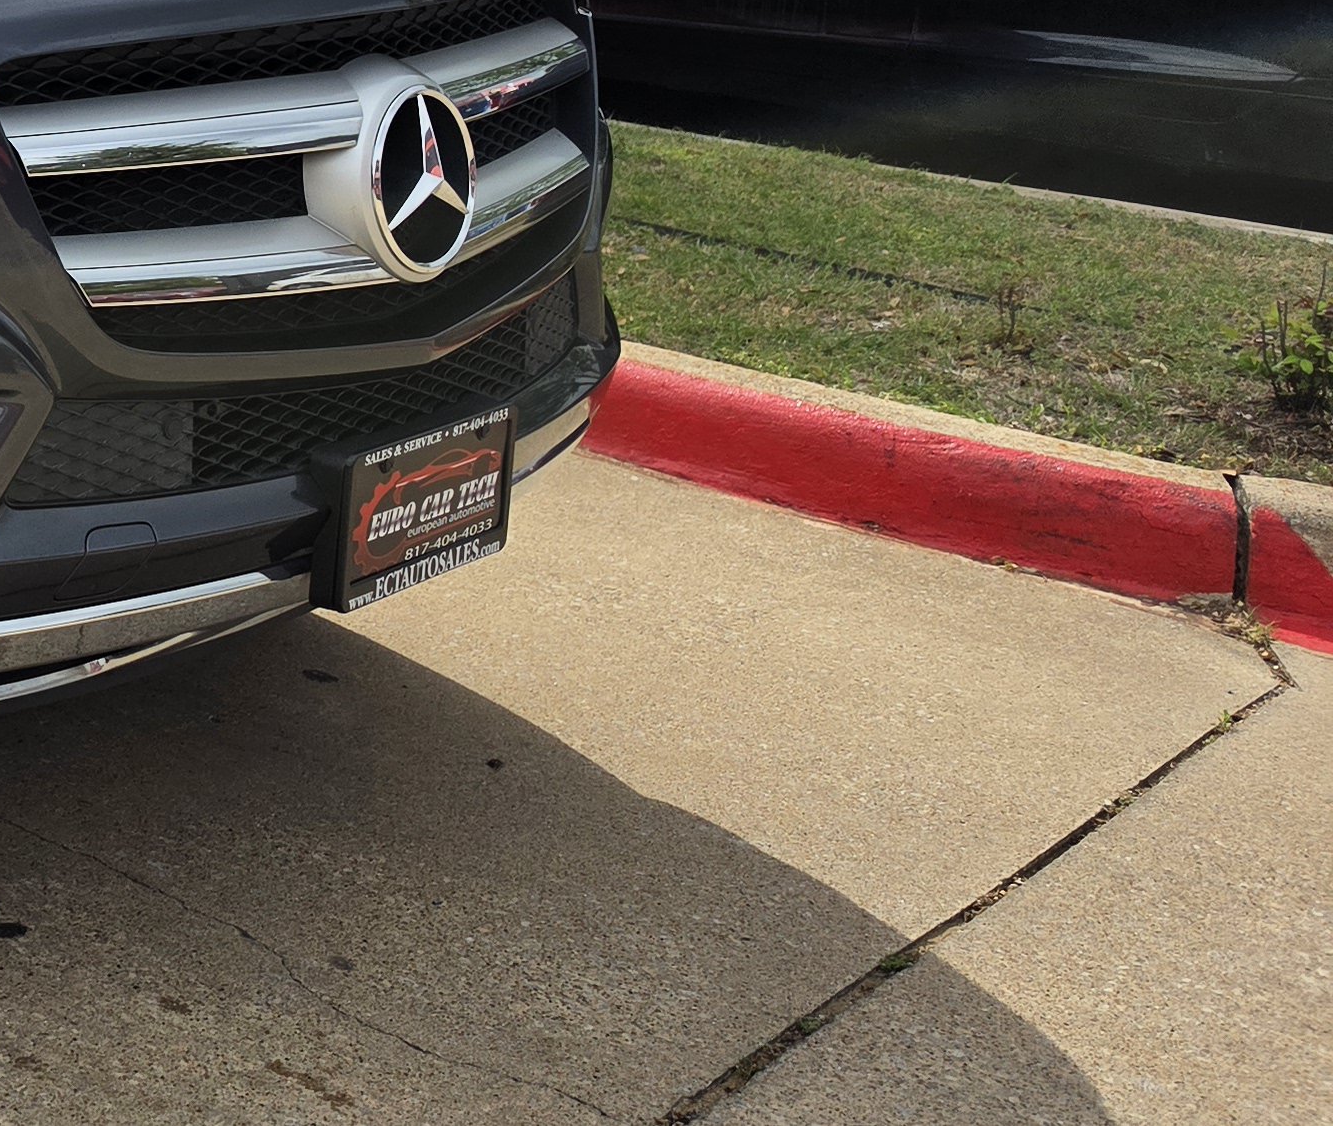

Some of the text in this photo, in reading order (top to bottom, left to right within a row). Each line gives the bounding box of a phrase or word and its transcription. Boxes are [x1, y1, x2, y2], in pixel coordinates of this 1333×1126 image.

[364, 407, 509, 467] SALES & SERVICE 817-404-4033
[367, 470, 500, 543] EURO CAR TECH
[407, 497, 496, 539] european automotive
[404, 518, 493, 561] 817-404-4033
[348, 538, 501, 611] www.ECTAUTOSALES.com
